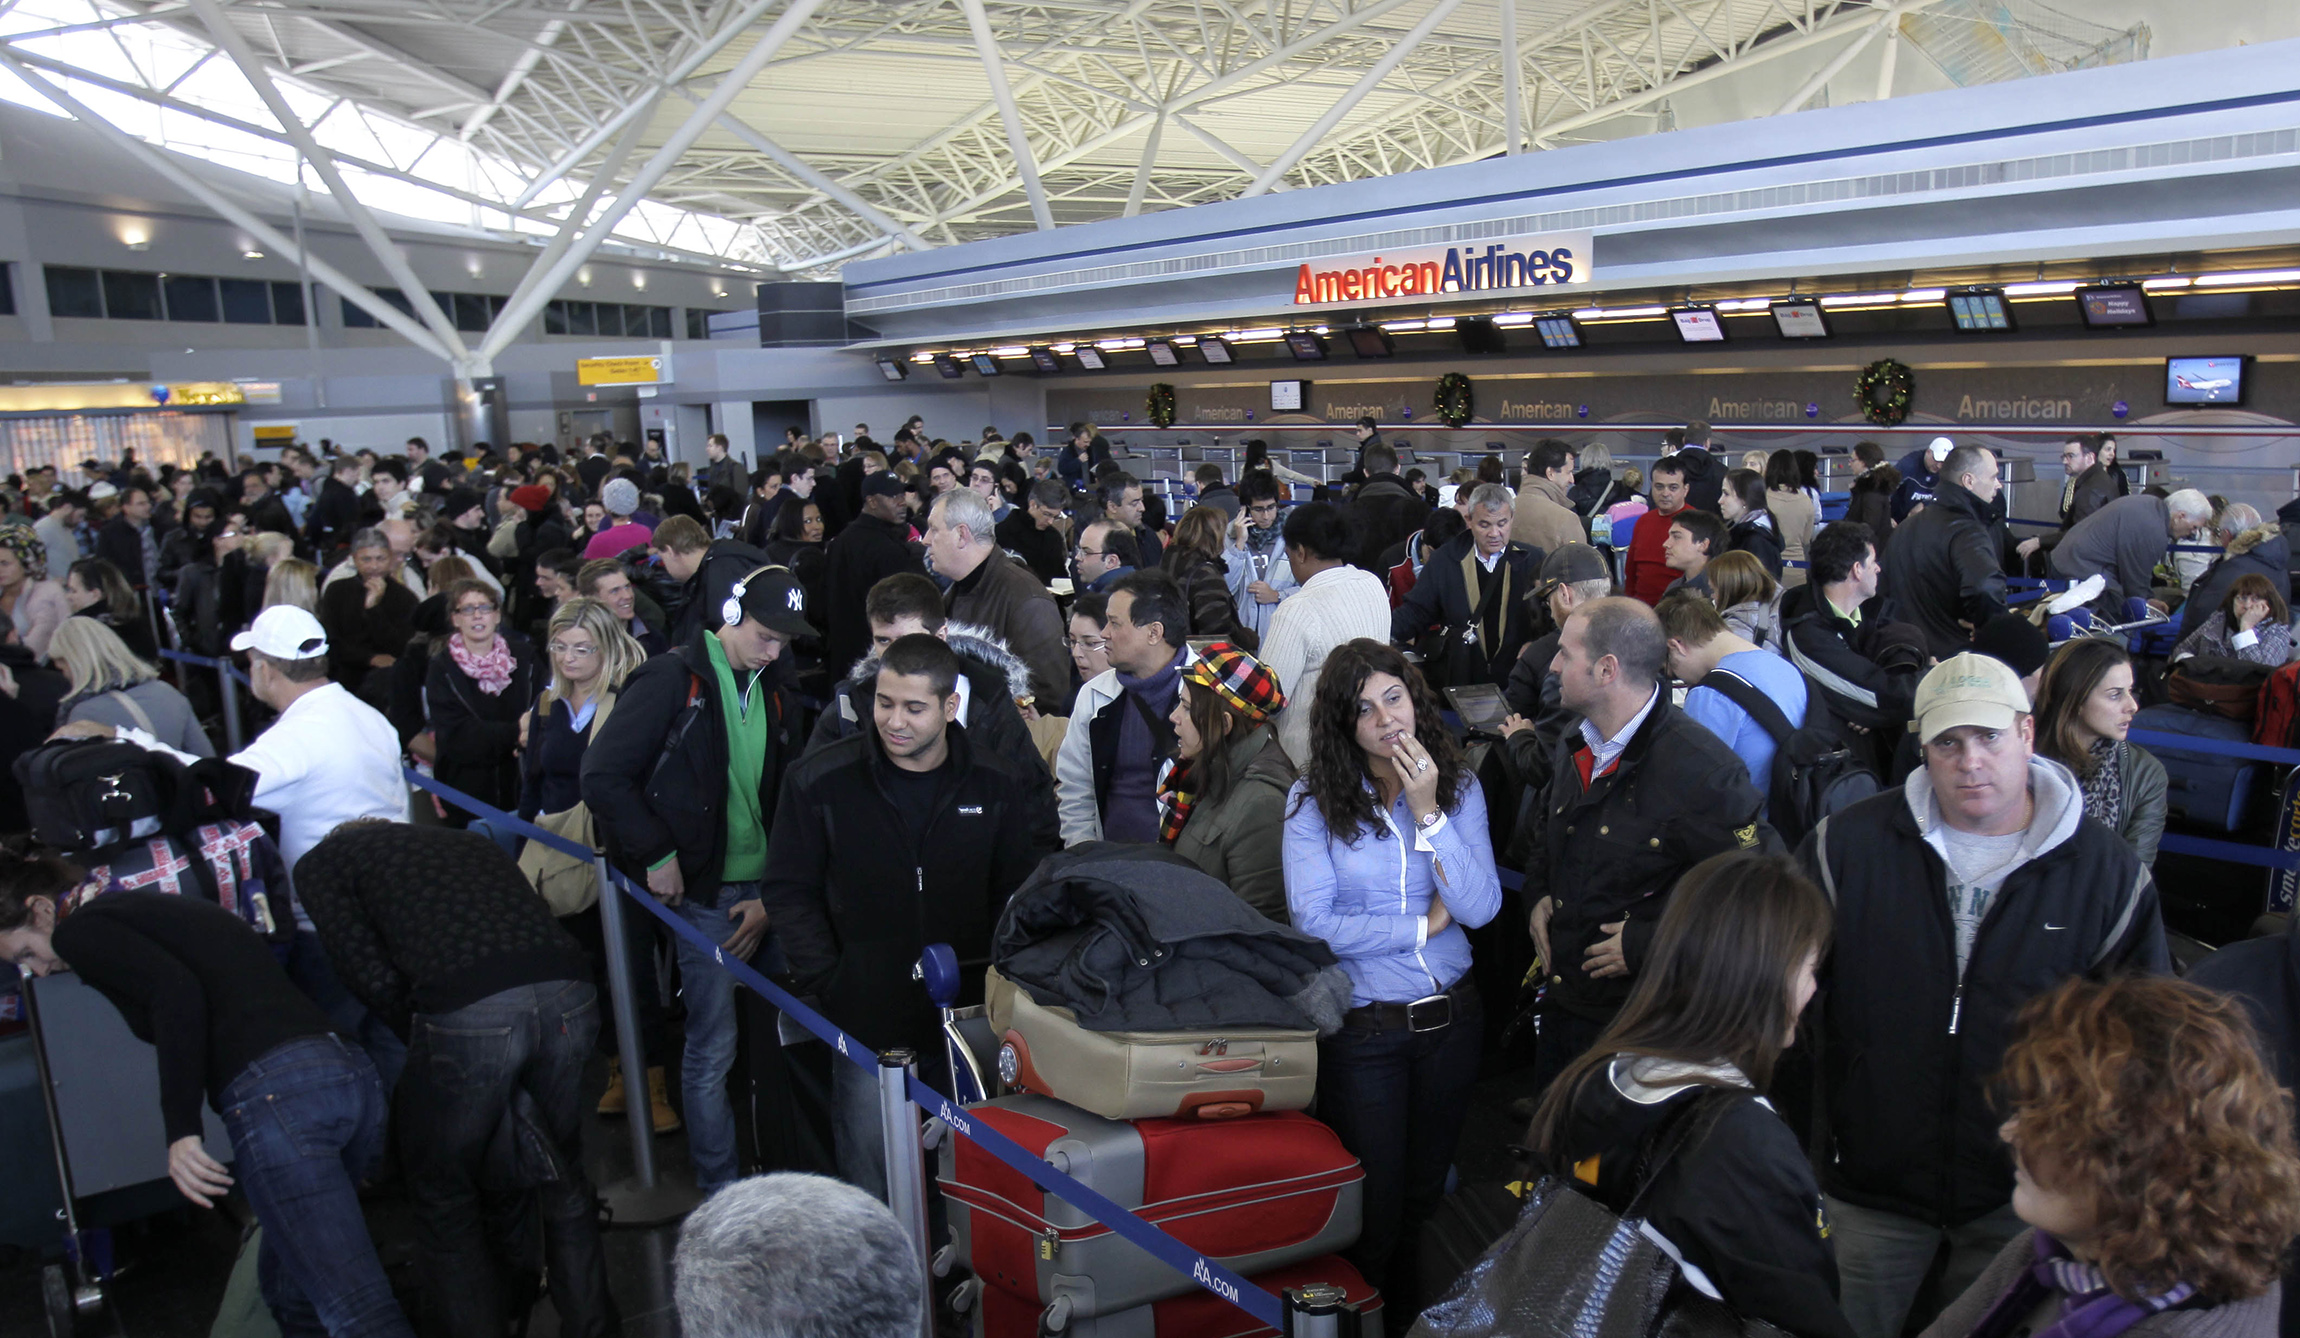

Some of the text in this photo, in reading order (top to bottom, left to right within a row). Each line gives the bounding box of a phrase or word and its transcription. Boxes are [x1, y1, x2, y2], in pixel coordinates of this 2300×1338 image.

[1194, 405, 1243, 421] American
[1325, 402, 1384, 420] American
[1500, 399, 1572, 419] American
[1708, 397, 1798, 418] American
[1957, 394, 2072, 418] American
[940, 1102, 971, 1136] AA.COM
[1193, 1259, 1240, 1303] AA.COM
